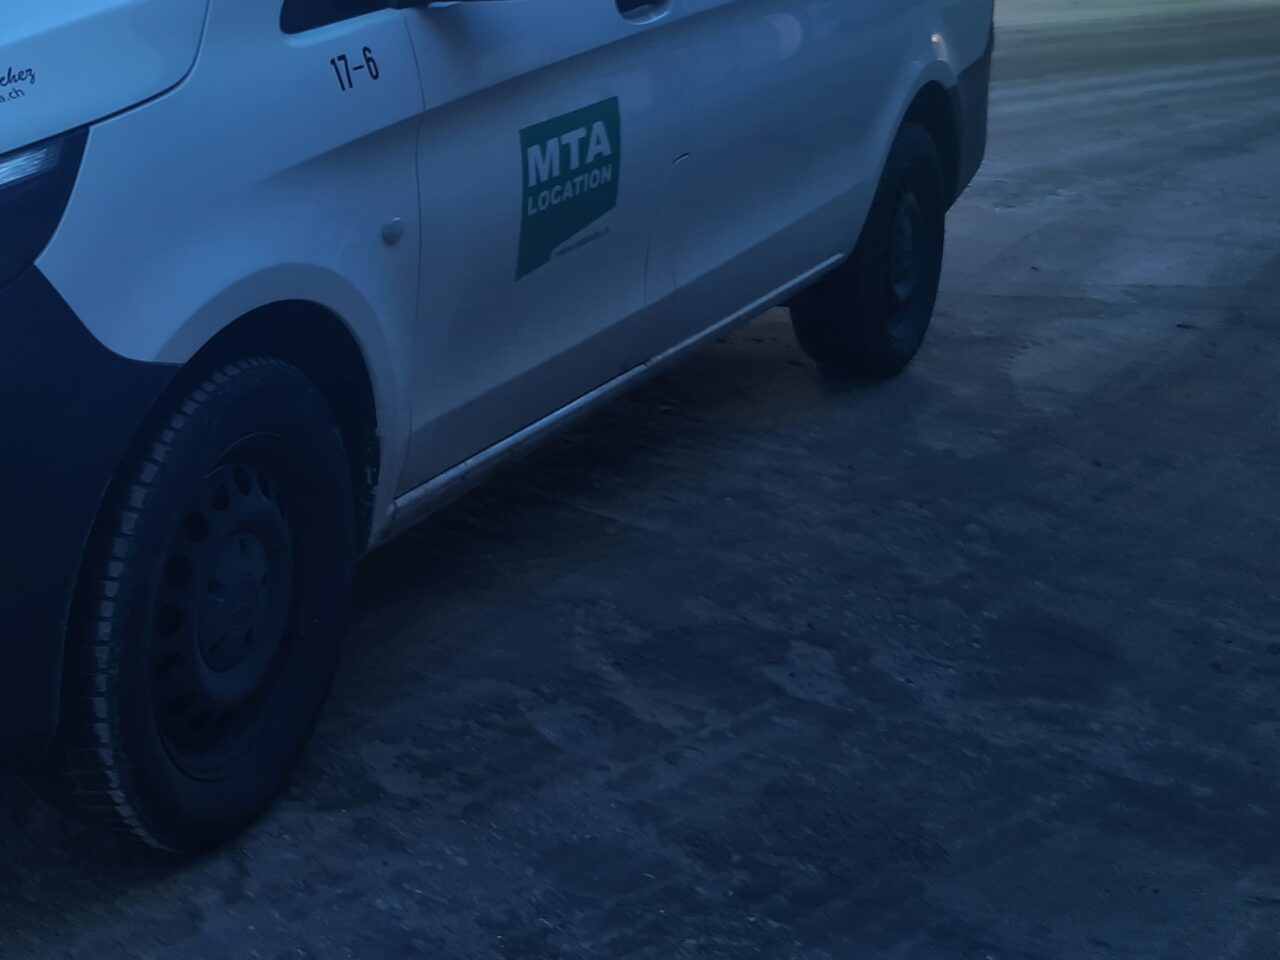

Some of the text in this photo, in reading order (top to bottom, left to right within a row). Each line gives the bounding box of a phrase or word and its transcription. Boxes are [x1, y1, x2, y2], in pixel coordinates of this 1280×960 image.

[0, 66, 36, 87] chez
[330, 46, 380, 91] 17-6
[527, 121, 613, 187] MTA
[527, 164, 613, 216] LOCATION
